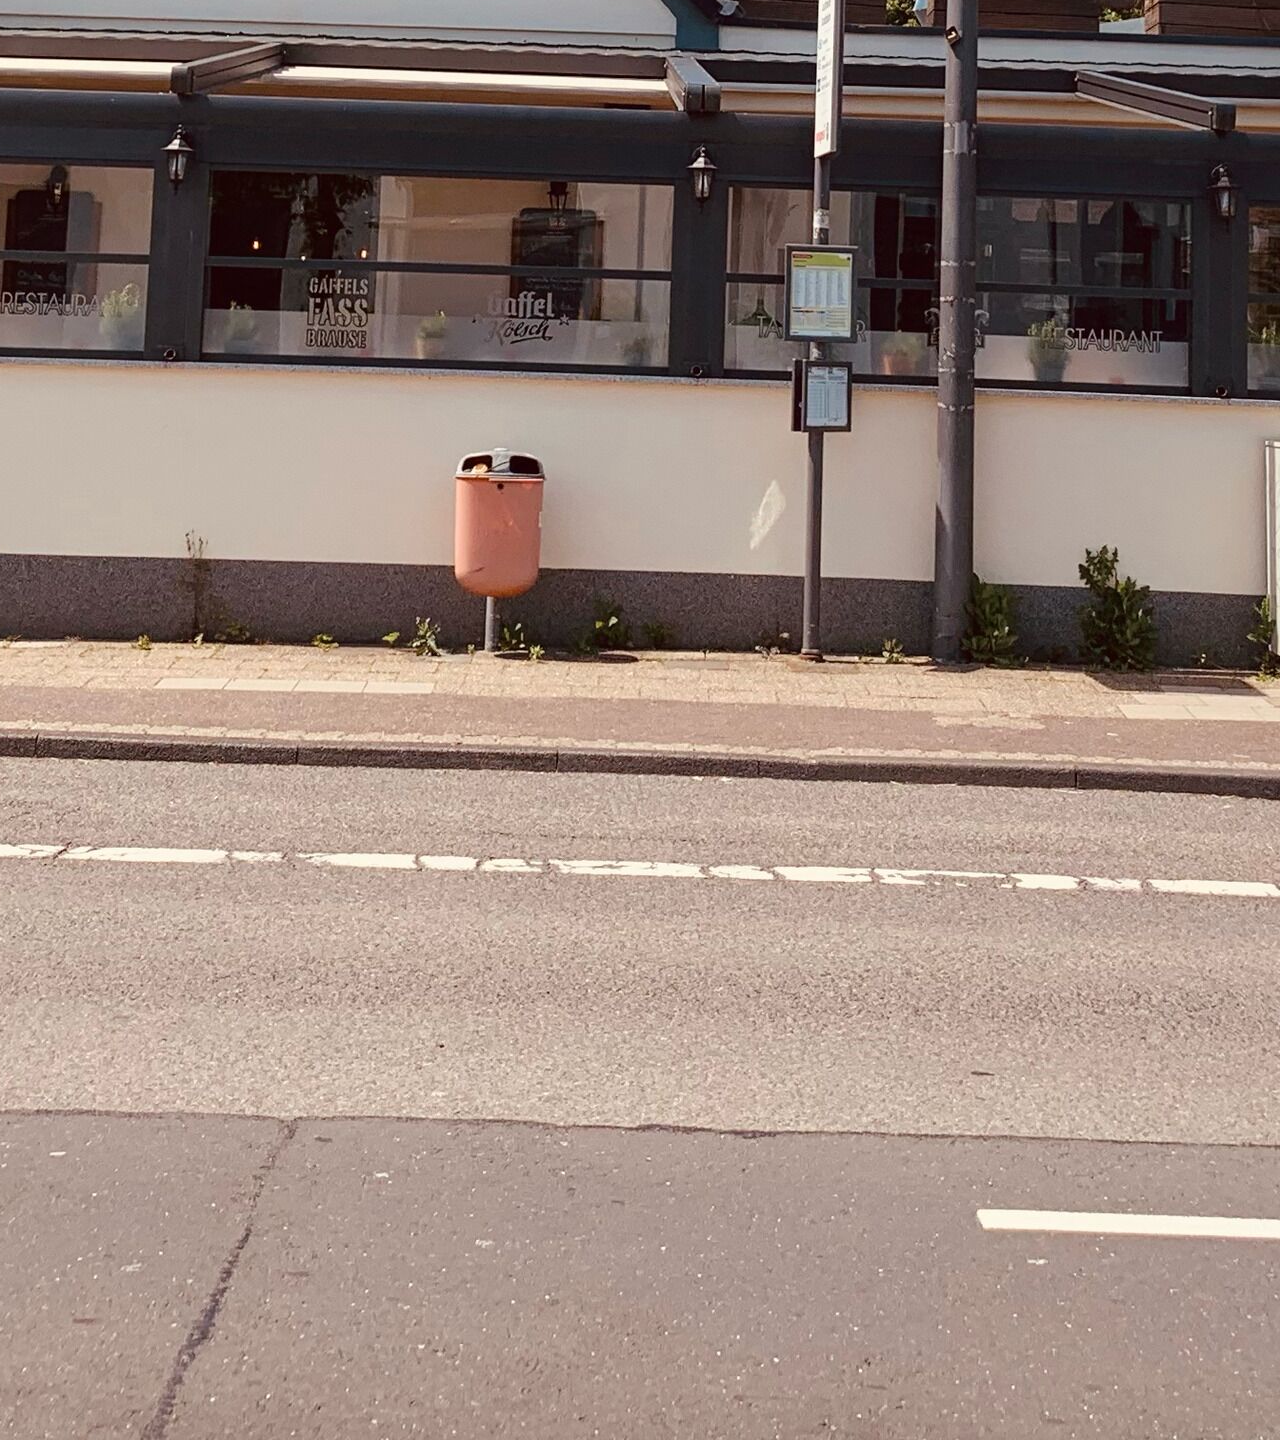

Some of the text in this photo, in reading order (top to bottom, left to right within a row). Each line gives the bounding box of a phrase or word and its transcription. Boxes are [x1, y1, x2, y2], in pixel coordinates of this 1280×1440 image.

[309, 277, 369, 295] GAFFELS
[307, 297, 368, 327] FASS
[306, 330, 368, 349] BRAUSE
